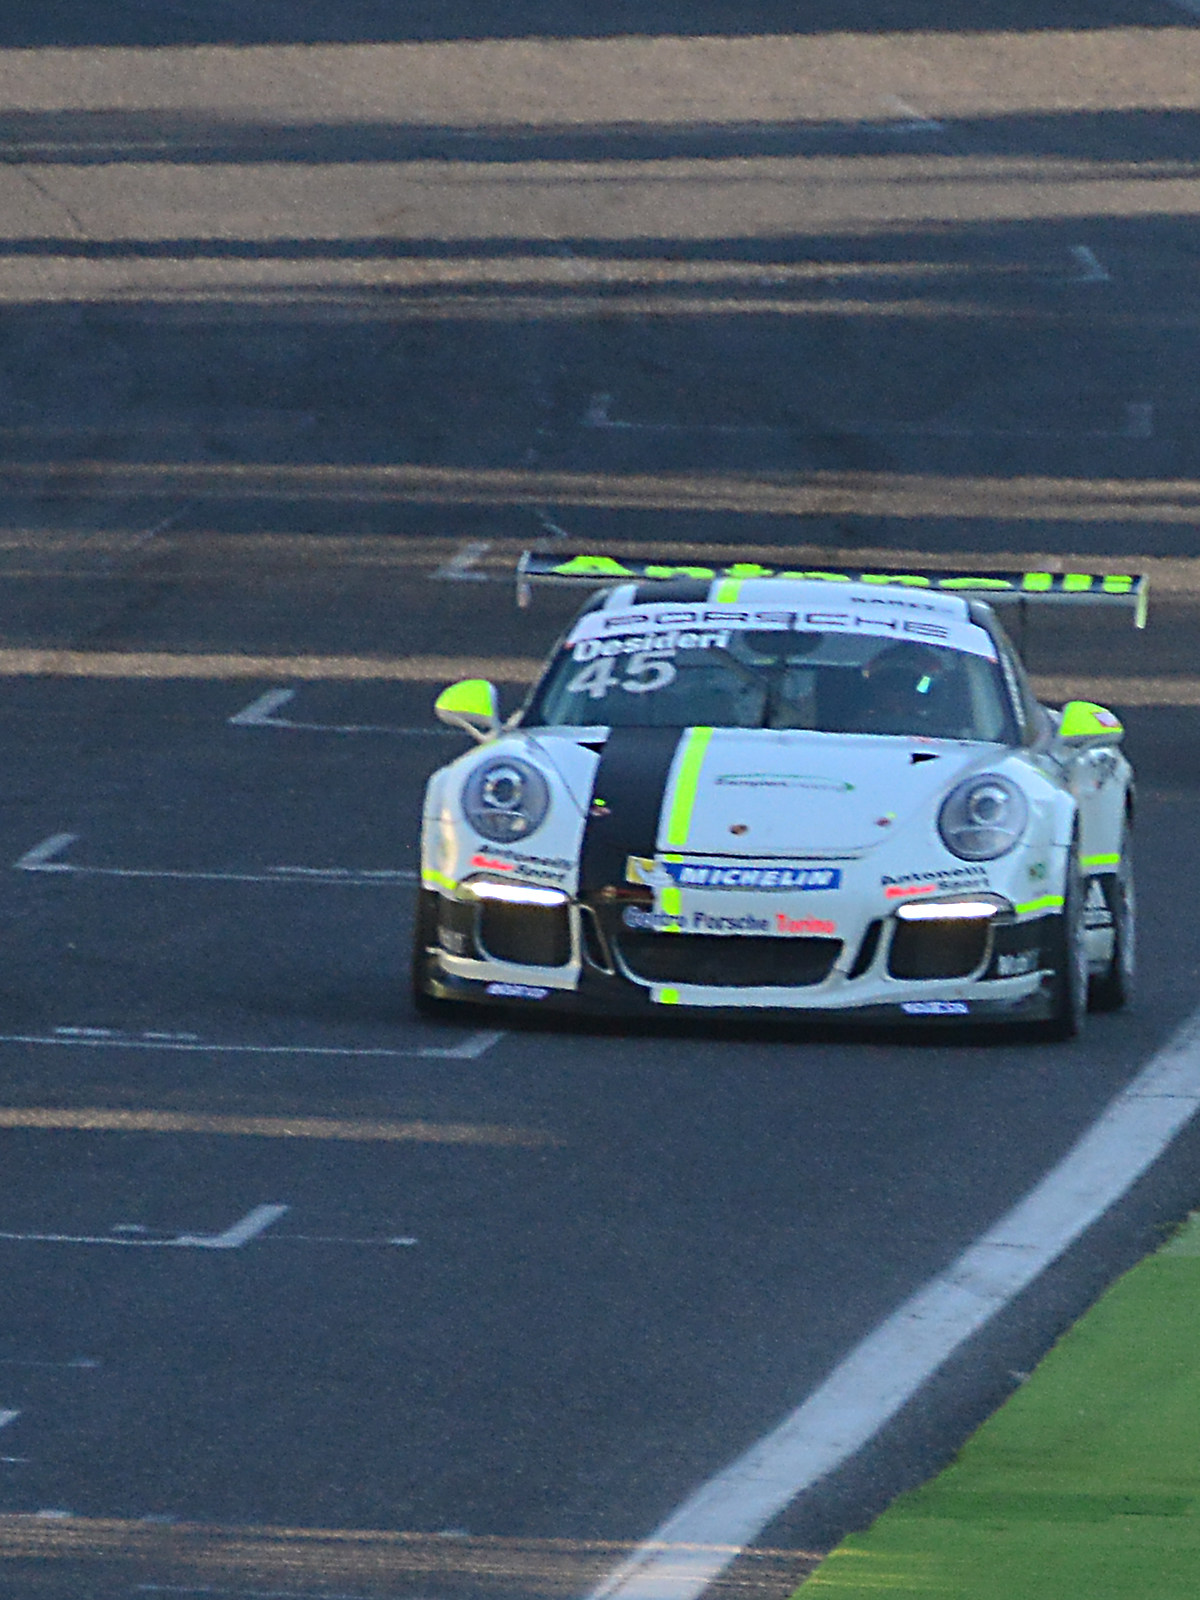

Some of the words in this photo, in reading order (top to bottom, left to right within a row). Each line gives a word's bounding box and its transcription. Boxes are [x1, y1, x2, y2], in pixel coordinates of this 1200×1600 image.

[604, 611, 949, 639] PORSCHE
[566, 650, 677, 698] 45
[679, 867, 835, 887] MICHELIN
[693, 912, 771, 931] Porsche
